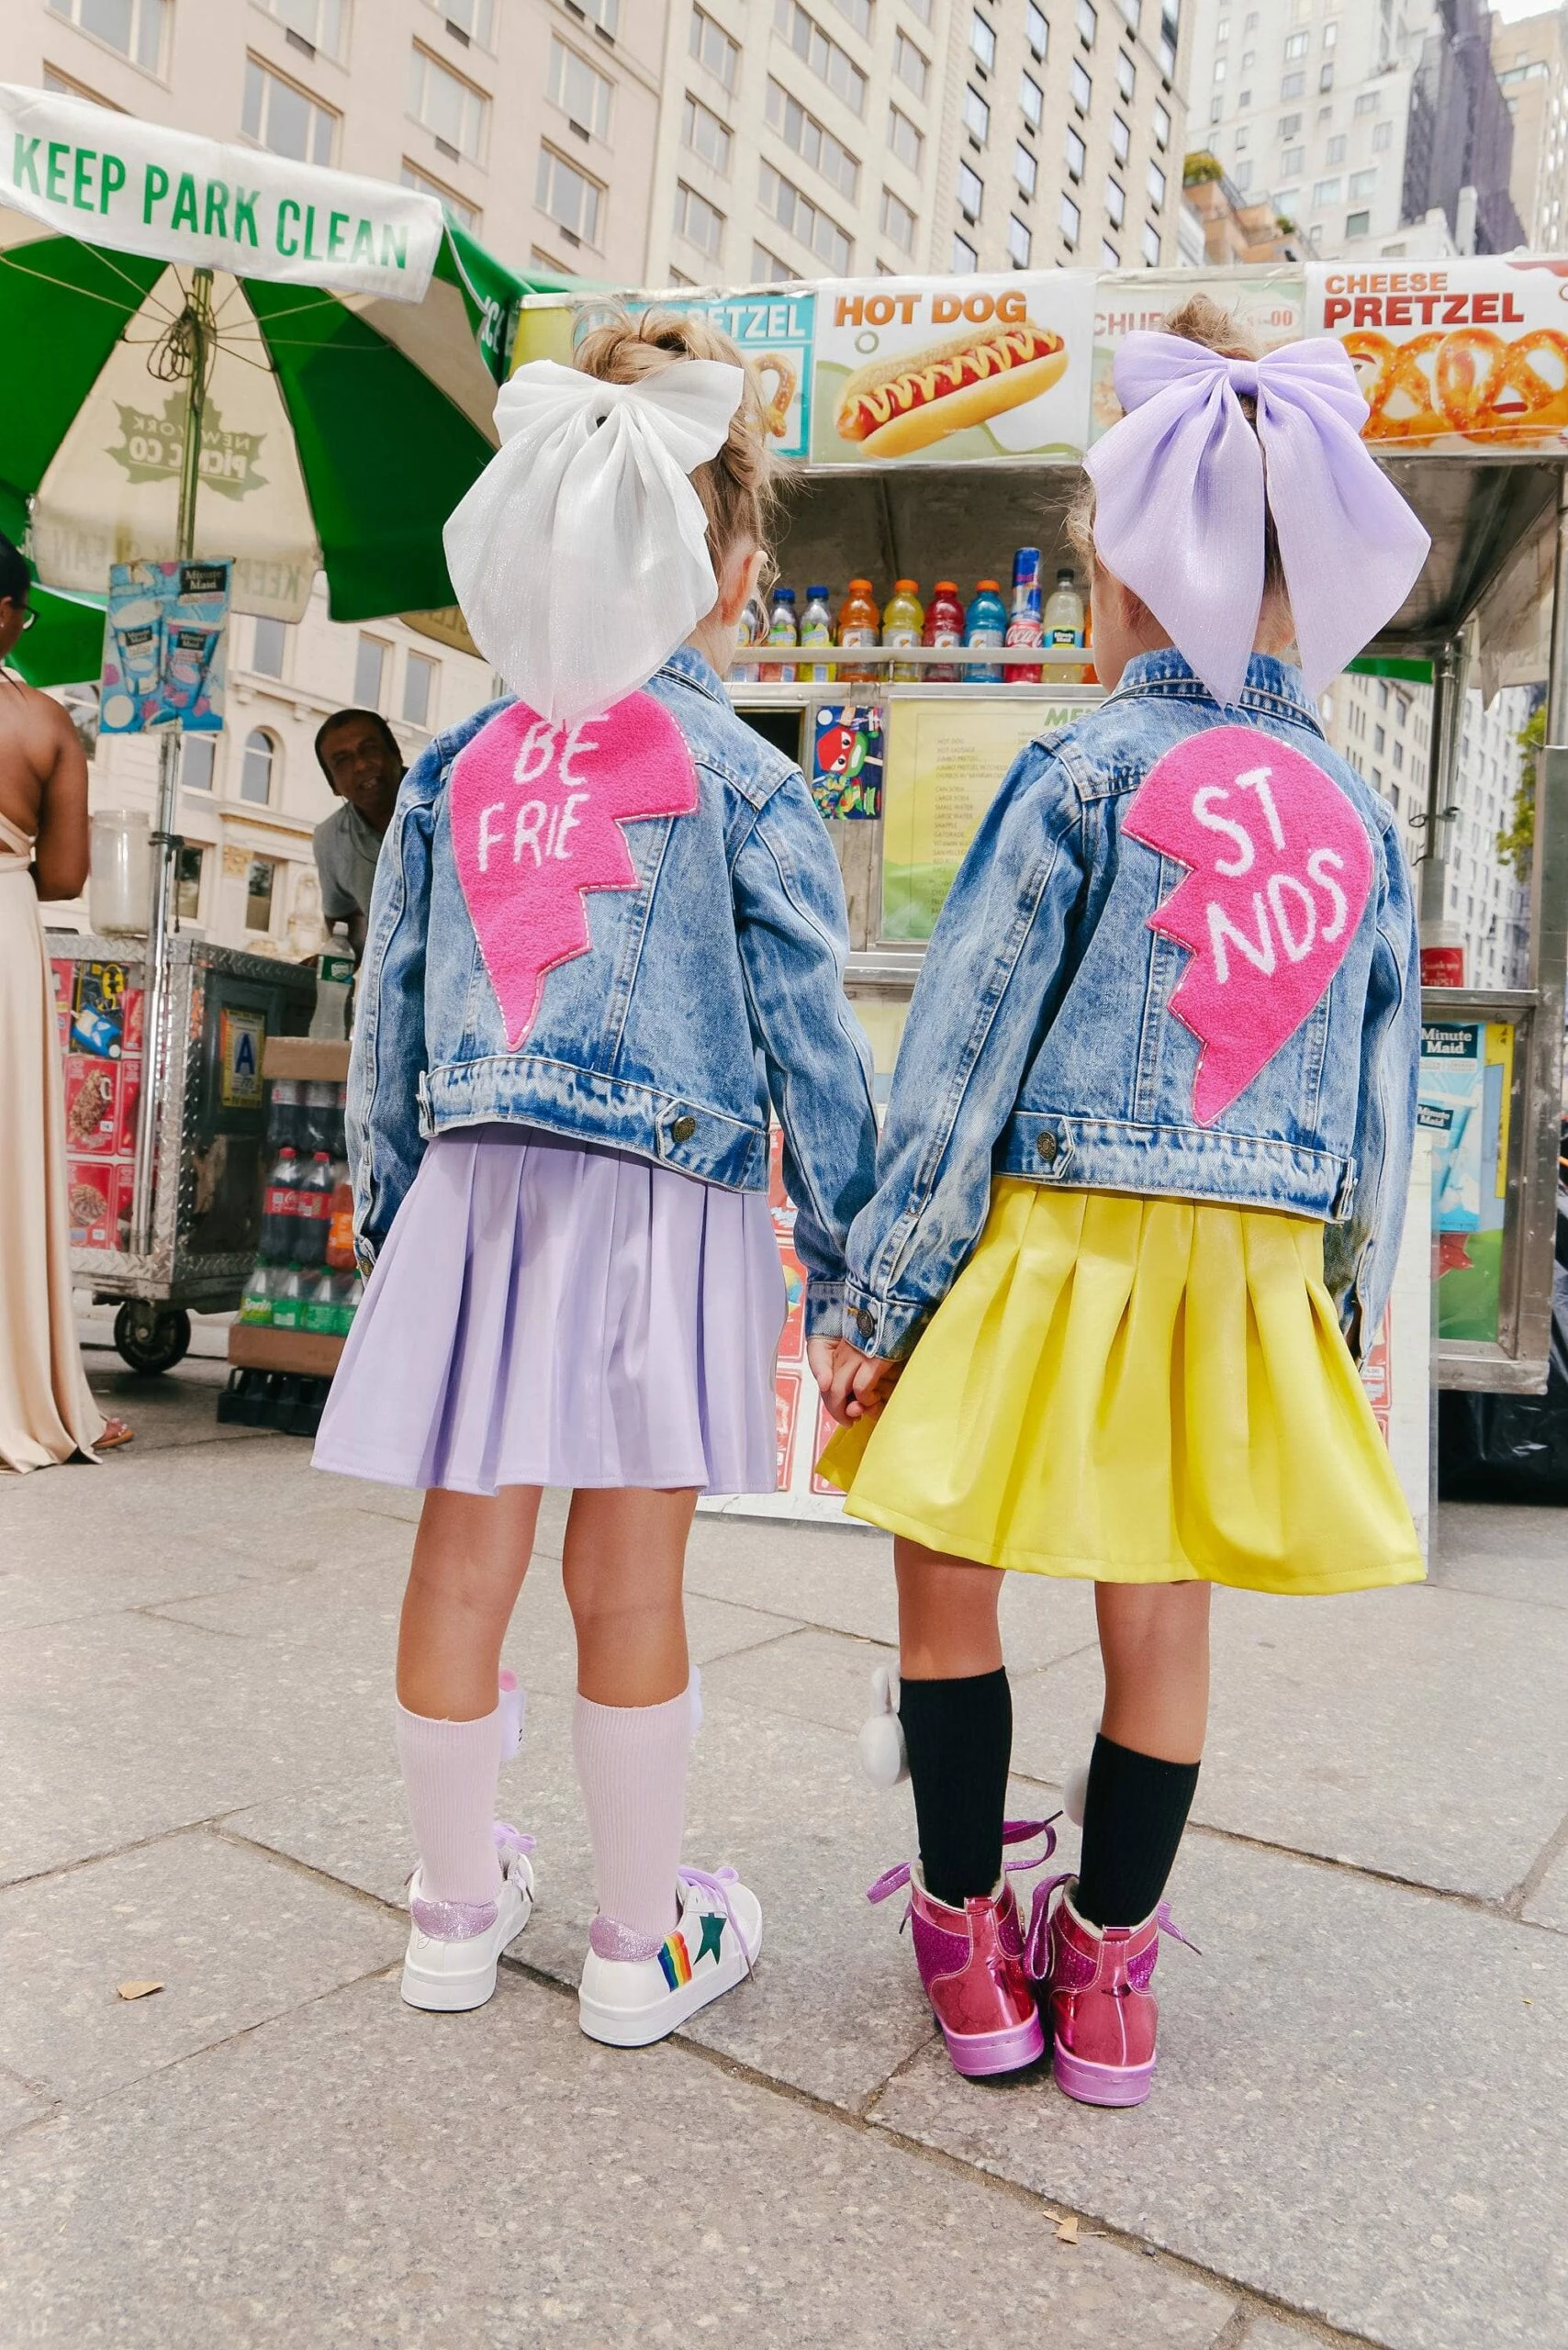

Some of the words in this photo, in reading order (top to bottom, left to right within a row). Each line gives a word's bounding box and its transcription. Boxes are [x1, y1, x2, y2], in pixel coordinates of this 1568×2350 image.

[13, 132, 126, 215] KEEP
[142, 163, 261, 248] PARK
[276, 199, 409, 270] CLEAN
[1325, 271, 1449, 295] CHEESE
[687, 304, 805, 339] ETZEL
[835, 293, 923, 327] HOT
[931, 289, 1027, 324] DOG
[1323, 292, 1525, 329] PRETZEL
[513, 713, 610, 787] BE
[477, 793, 591, 872] FRIE
[1193, 767, 1286, 878] ST
[1205, 848, 1349, 984] NDS
[235, 1032, 255, 1073] A
[1421, 1028, 1473, 1042] Minute
[1427, 1040, 1466, 1055] Maid
